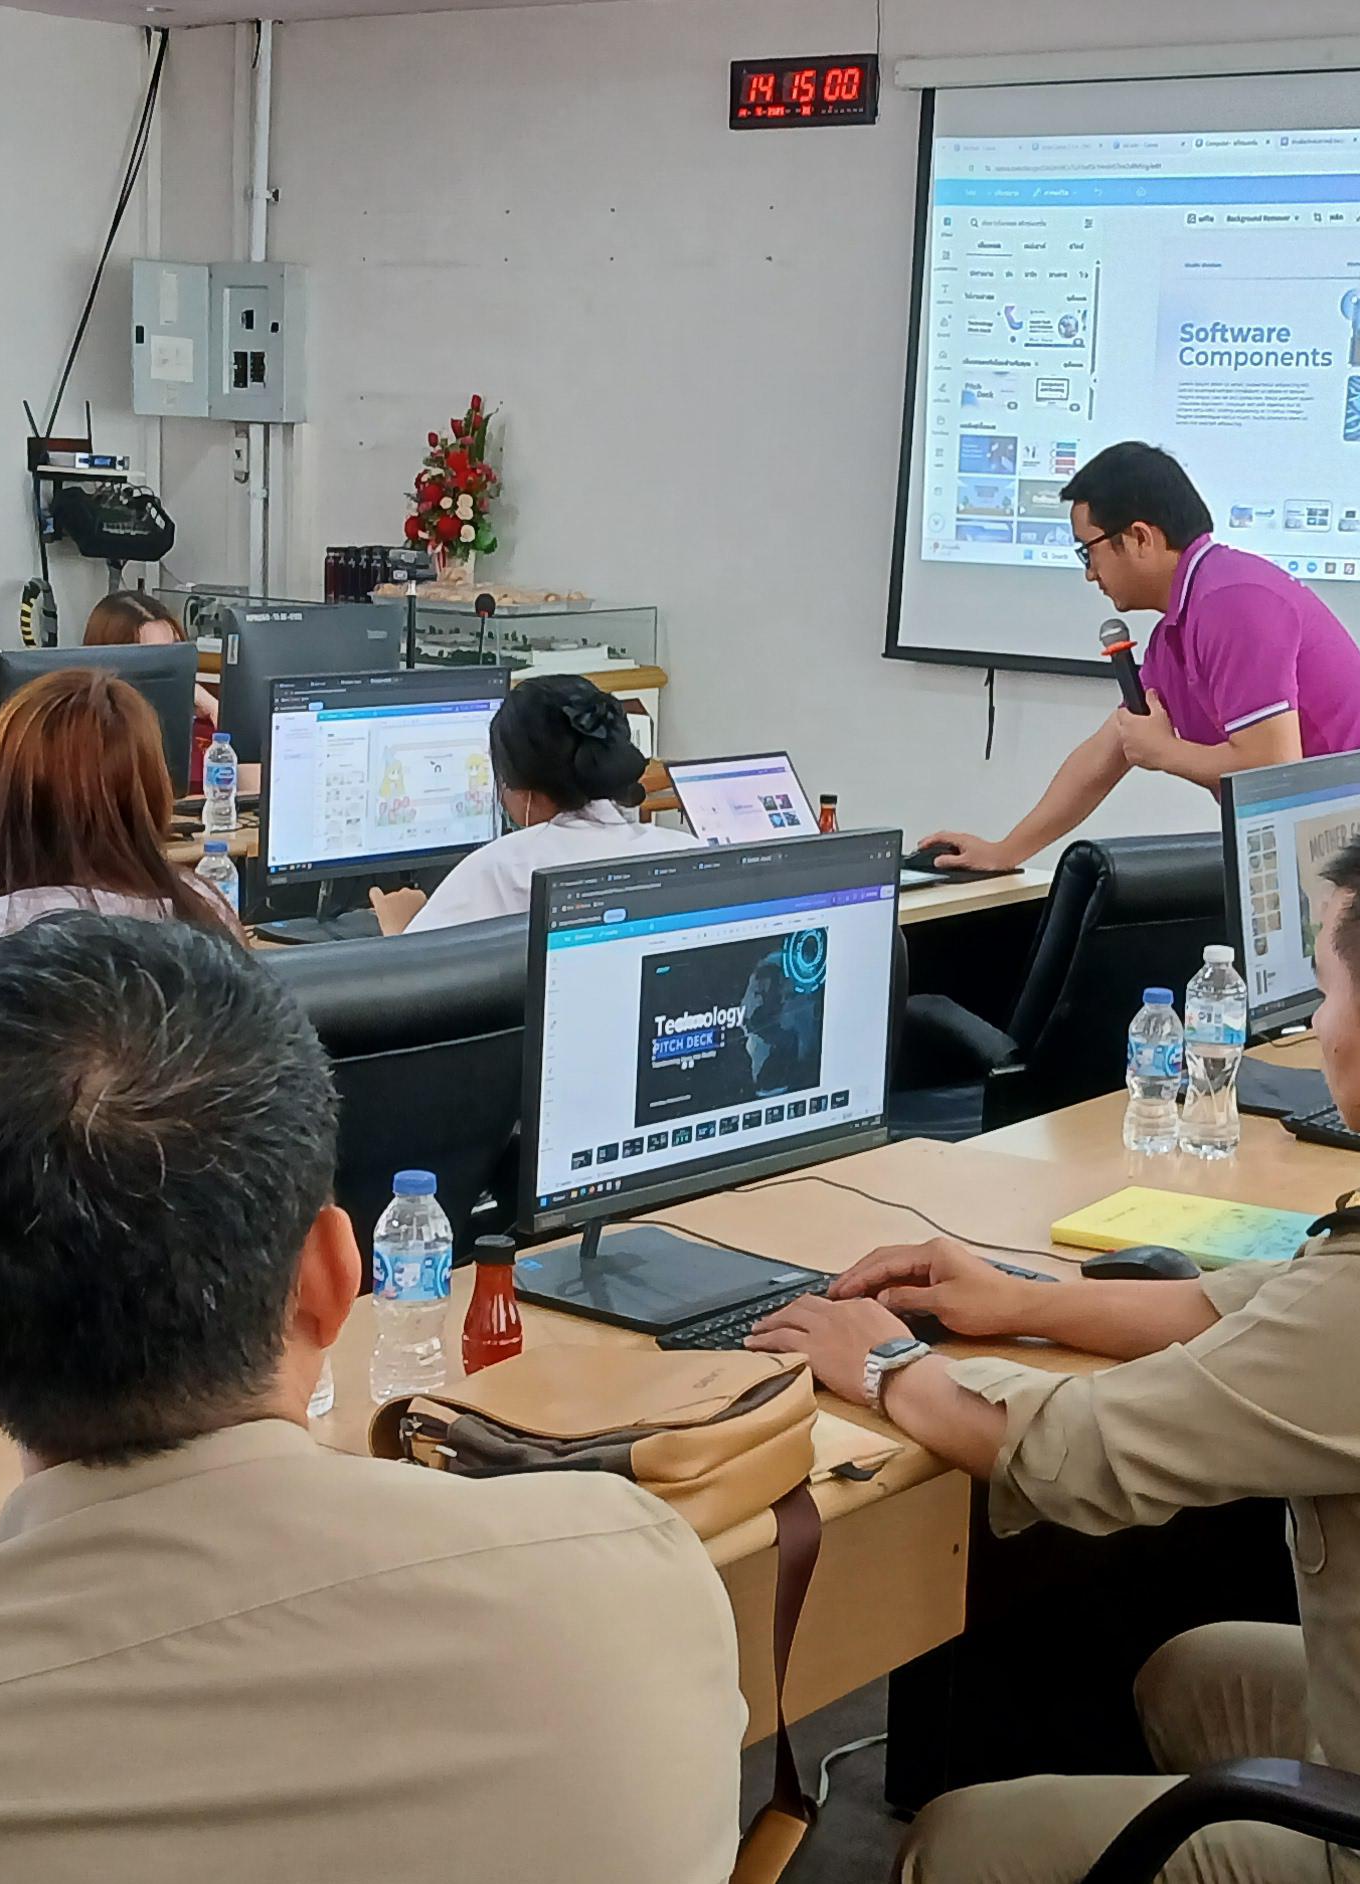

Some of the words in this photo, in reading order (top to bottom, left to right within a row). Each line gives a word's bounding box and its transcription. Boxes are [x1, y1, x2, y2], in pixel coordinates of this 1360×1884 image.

[748, 73, 776, 103] 14
[791, 69, 818, 103] 15
[822, 66, 860, 101] 00
[1180, 322, 1291, 343] Software
[1179, 346, 1333, 371] Components
[654, 1005, 747, 1037] Technology
[653, 1038, 684, 1054] PITCH
[686, 1031, 713, 1048] DECK
